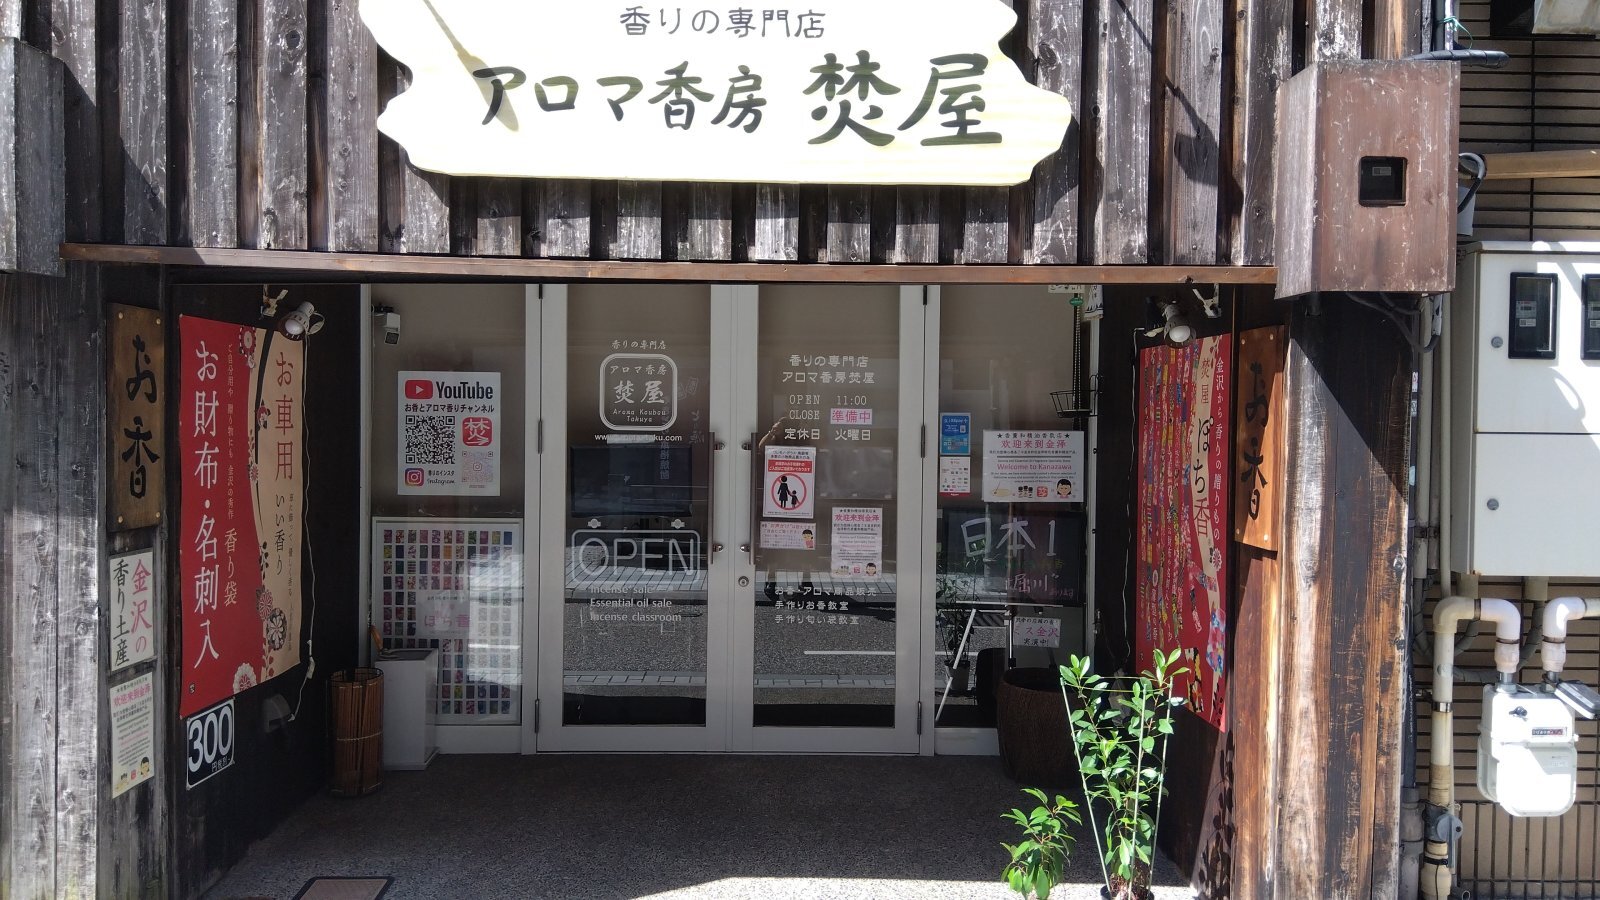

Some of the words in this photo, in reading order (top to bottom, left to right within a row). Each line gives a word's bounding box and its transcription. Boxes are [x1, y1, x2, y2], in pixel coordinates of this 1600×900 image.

[619, 6, 826, 39] 香りの専門店
[472, 60, 766, 134] アロマ香房
[802, 50, 1002, 147] 焚屋
[611, 340, 666, 350] 香りの専門店
[609, 364, 667, 376] アロマ香房
[789, 355, 869, 367] 香りの専門店
[782, 371, 875, 384] アロマ香房焚屋
[1200, 357, 1210, 404] 焚屋
[436, 381, 493, 399] YouTube
[613, 380, 665, 404] 焚屋
[404, 403, 494, 413] お香とアロマ香りチャンネル
[789, 395, 820, 405] OPEN
[836, 396, 867, 406] 11:00
[122, 334, 160, 498] お香
[275, 352, 294, 481] お車用
[789, 410, 820, 420] CLOSE
[831, 410, 871, 422] 準備中
[784, 428, 820, 440] 定休日
[835, 429, 871, 441] 火曜日
[1241, 362, 1268, 521] お香
[997, 463, 1027, 471] Welcome
[1030, 463, 1037, 471] to
[1038, 463, 1072, 471] Kanazawa
[1193, 416, 1214, 538] ぽち香
[193, 340, 220, 669] お財布・名刺入
[274, 494, 285, 576] いい香り
[578, 537, 694, 576] OPEN
[224, 527, 238, 607] 香り袋
[633, 586, 653, 594] sale
[775, 587, 876, 597] お香・アロマ商品販売
[131, 559, 152, 653] 金沢の
[590, 598, 633, 608] Essential
[637, 598, 648, 608] oil
[652, 598, 672, 608] sale
[775, 601, 849, 611] 手作りお香教室
[113, 559, 130, 666] 香り土産
[632, 612, 681, 622] classroom
[775, 615, 859, 625] 手作り匂い袋教室
[188, 705, 232, 773] 300
